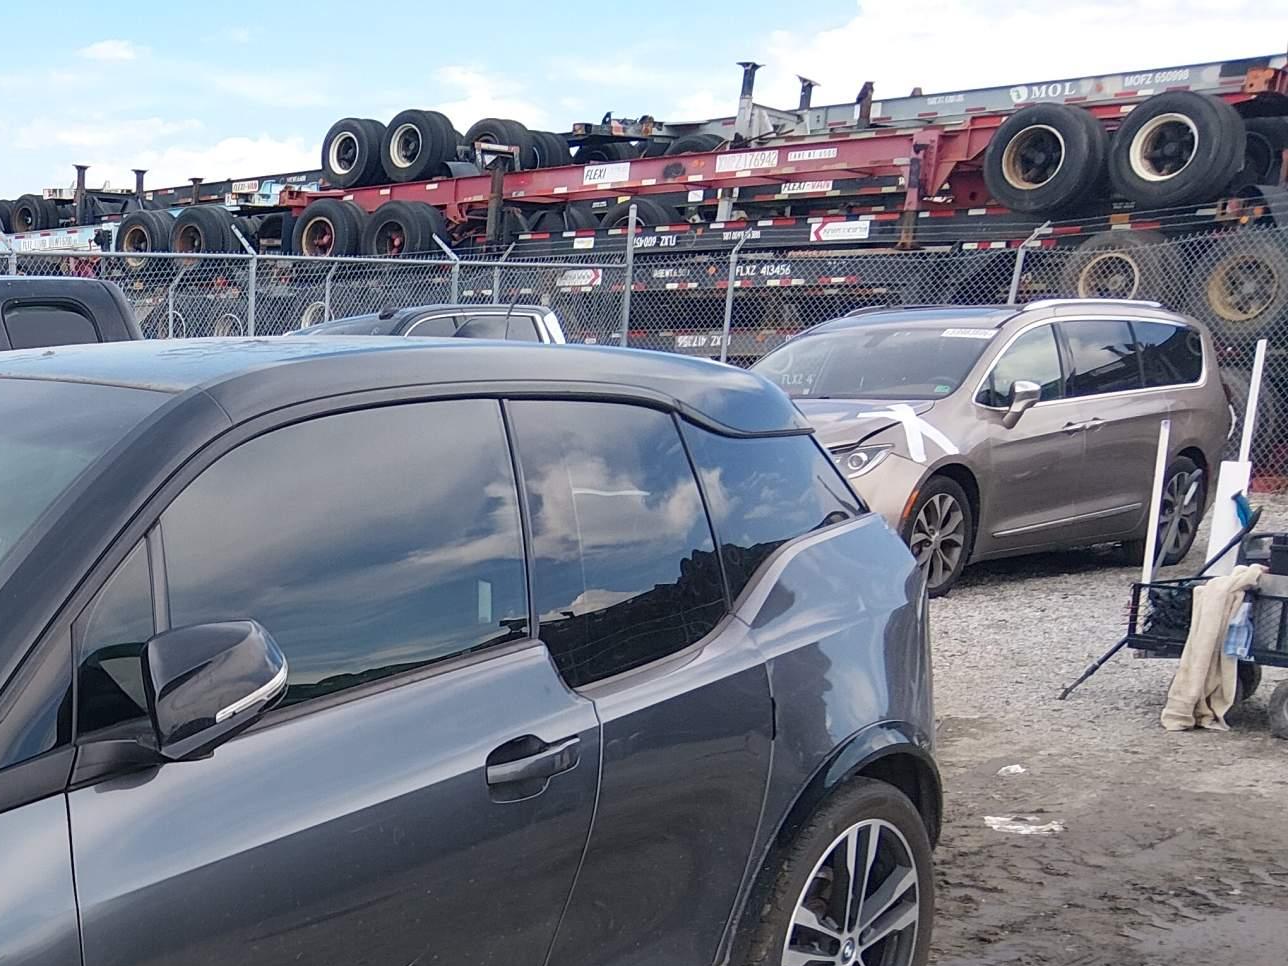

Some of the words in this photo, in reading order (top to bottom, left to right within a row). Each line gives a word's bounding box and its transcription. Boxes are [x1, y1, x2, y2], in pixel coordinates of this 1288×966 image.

[1031, 82, 1076, 100] MOL
[585, 168, 607, 181] FLEXI
[735, 265, 756, 276] FLXZ
[760, 263, 791, 276] 413456
